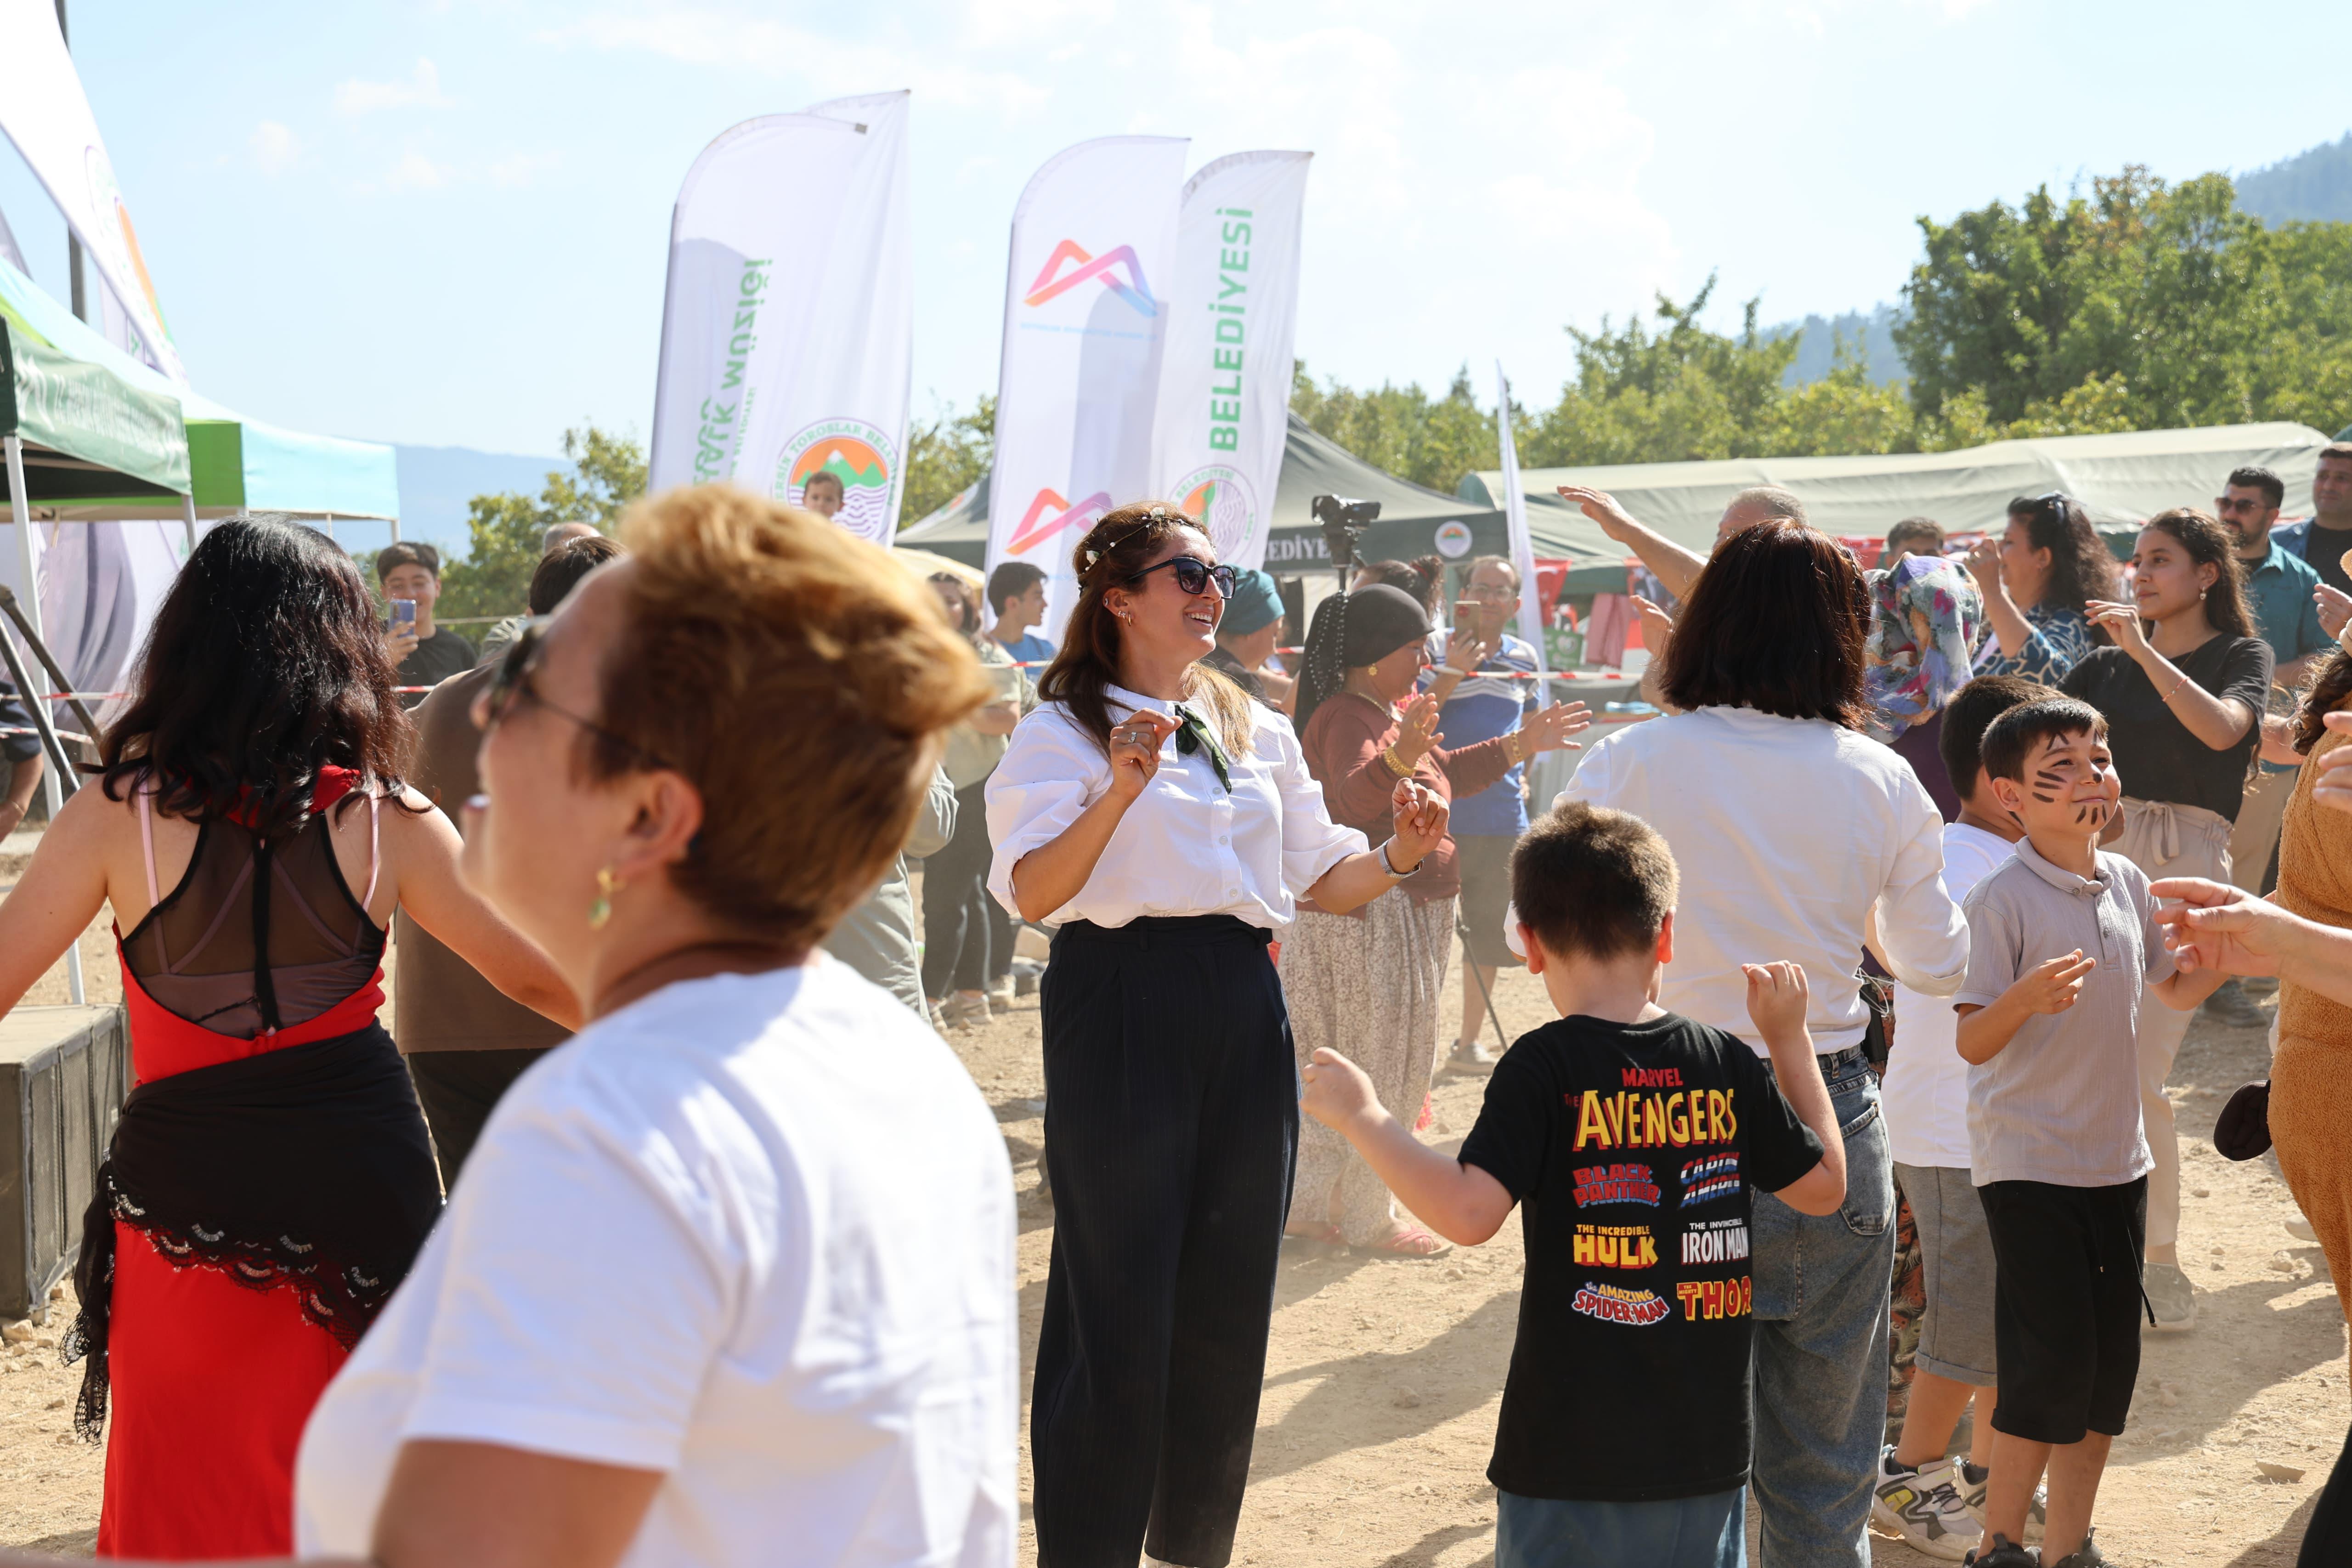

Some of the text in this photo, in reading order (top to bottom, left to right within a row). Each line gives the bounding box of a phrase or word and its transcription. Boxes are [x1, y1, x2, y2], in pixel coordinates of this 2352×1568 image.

[1208, 208, 1253, 451] BELEDİYESİ
[775, 455, 791, 499] ERSİN
[790, 422, 862, 454] TOROSLAR
[1622, 1068, 1683, 1087] MARVEL
[1572, 1088, 1737, 1152] AVENGERS
[1572, 1163, 1653, 1186] BLACK
[1572, 1181, 1661, 1208] PANTHER
[1576, 1224, 1650, 1236] THE INCREDIBLE
[1689, 1222, 1706, 1230] THE
[1573, 1234, 1658, 1269] HULK
[1681, 1226, 1749, 1264] IRON MAN
[1572, 1289, 1670, 1325] SPIDER-MAN
[1598, 1283, 1655, 1303] AMAZING
[1677, 1276, 1752, 1321] THOR
